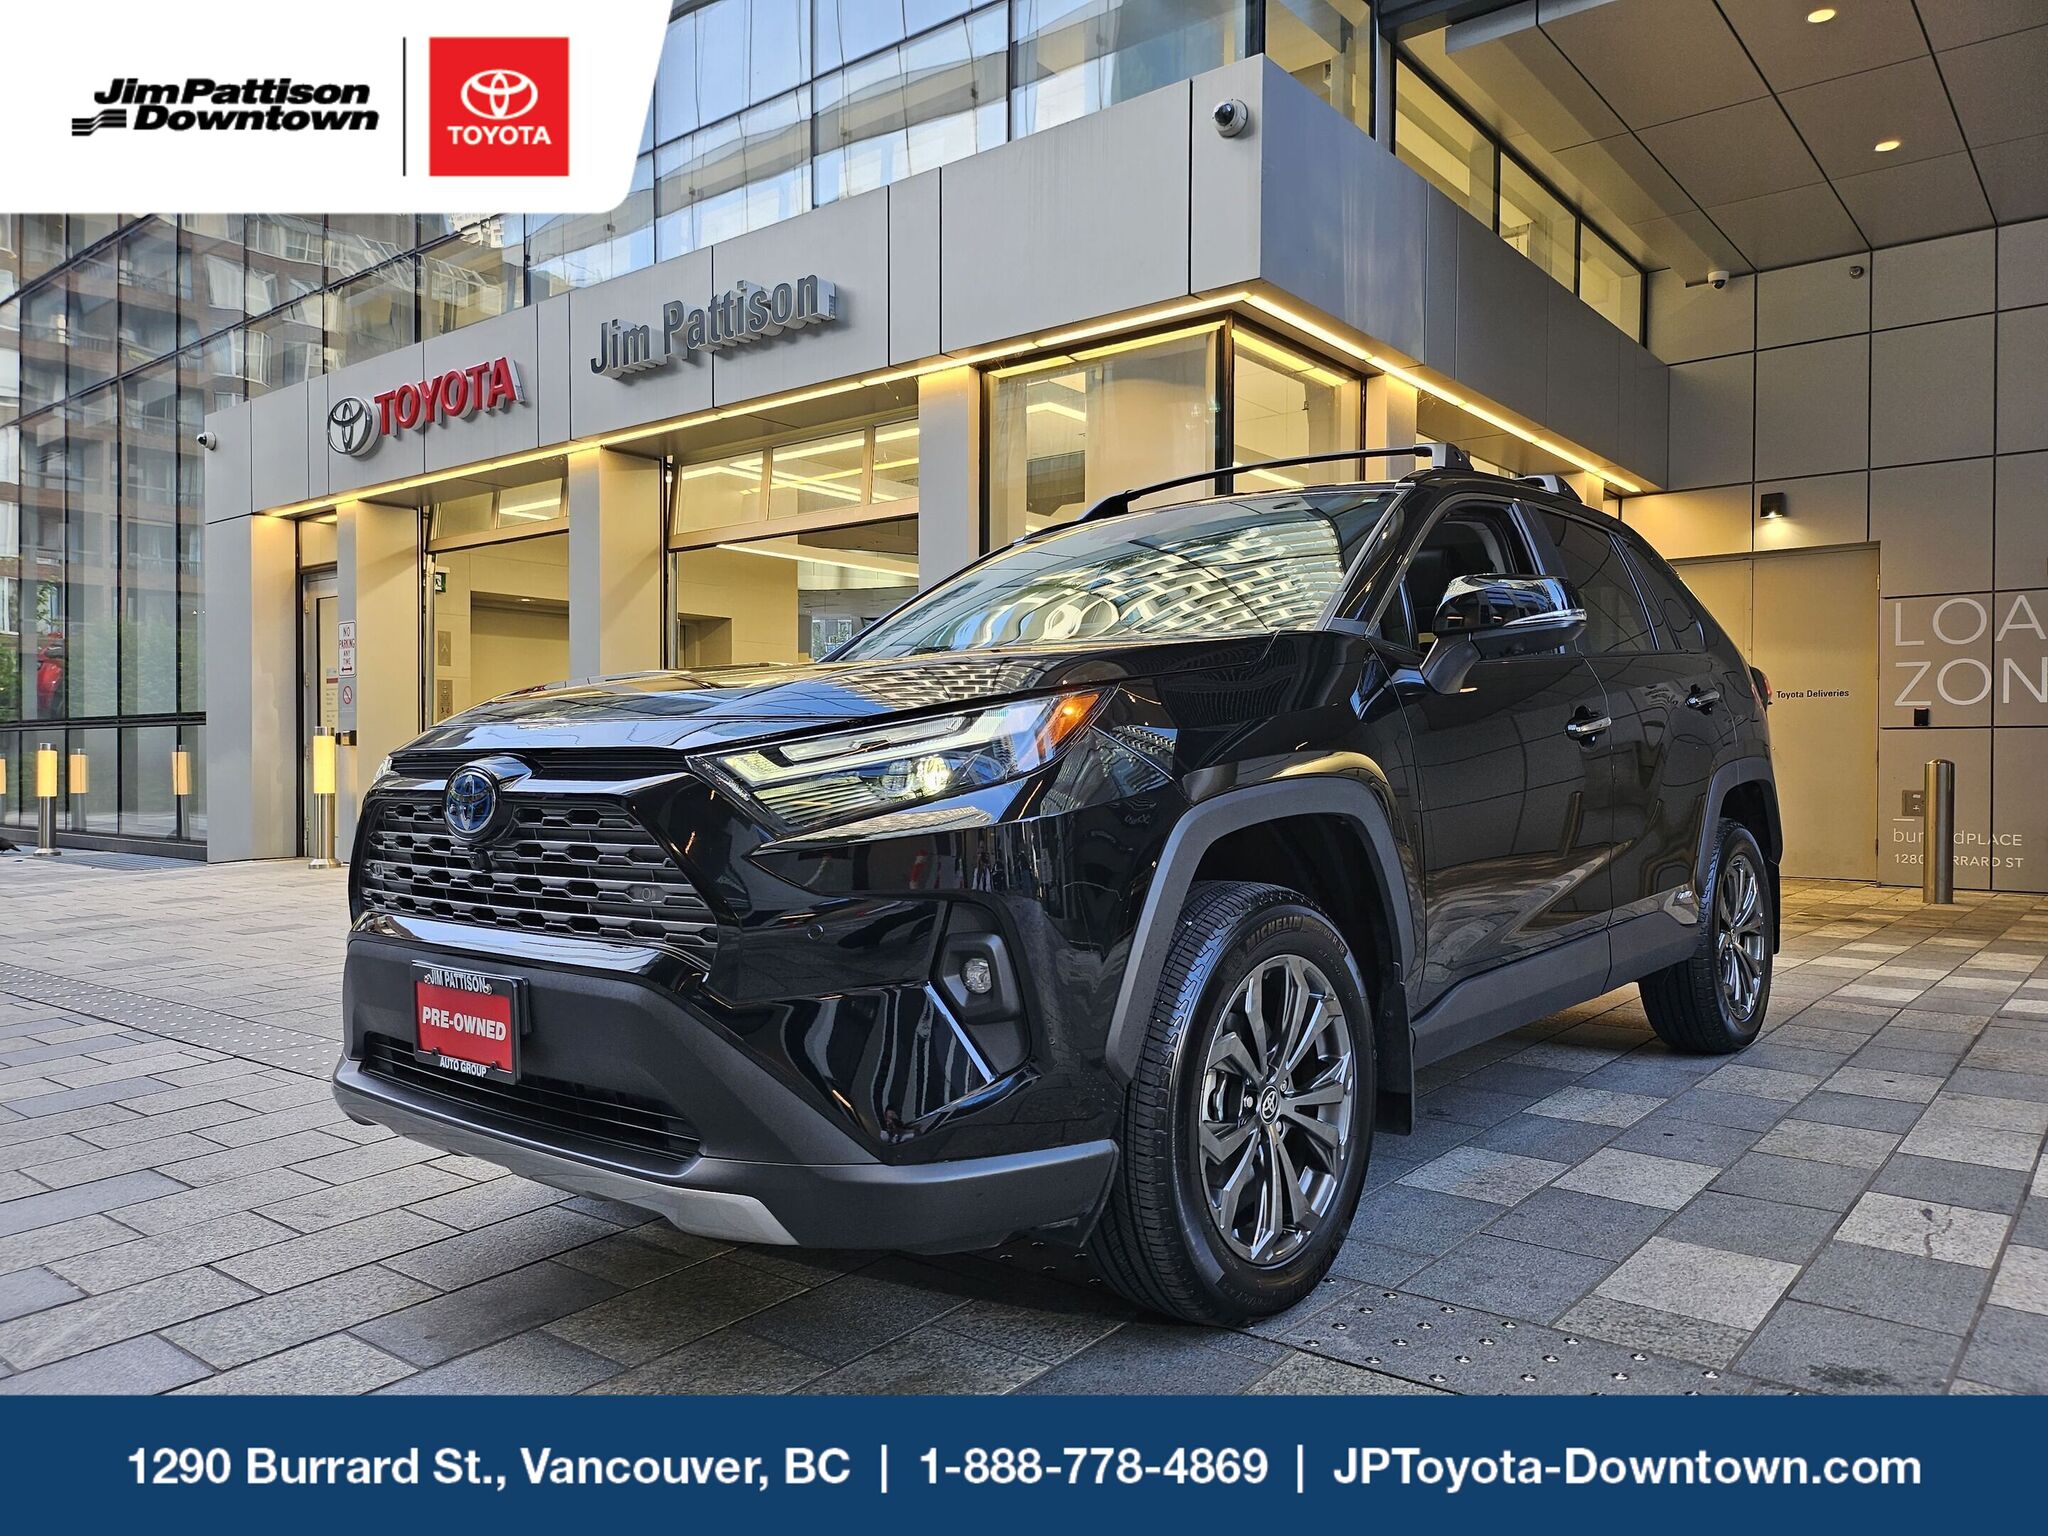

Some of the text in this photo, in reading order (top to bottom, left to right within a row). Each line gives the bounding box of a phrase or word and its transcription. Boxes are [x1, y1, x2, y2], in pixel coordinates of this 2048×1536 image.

[590, 270, 826, 378] Jim Pattison
[374, 356, 520, 436] TOYOTA
[1776, 689, 1850, 700] Toyota Deliveries
[2005, 857, 2024, 868] ST
[430, 968, 486, 993] JIM PATTISON
[422, 1006, 507, 1041] PRE-OWNED
[439, 1057, 488, 1077] AUTO GROUP
